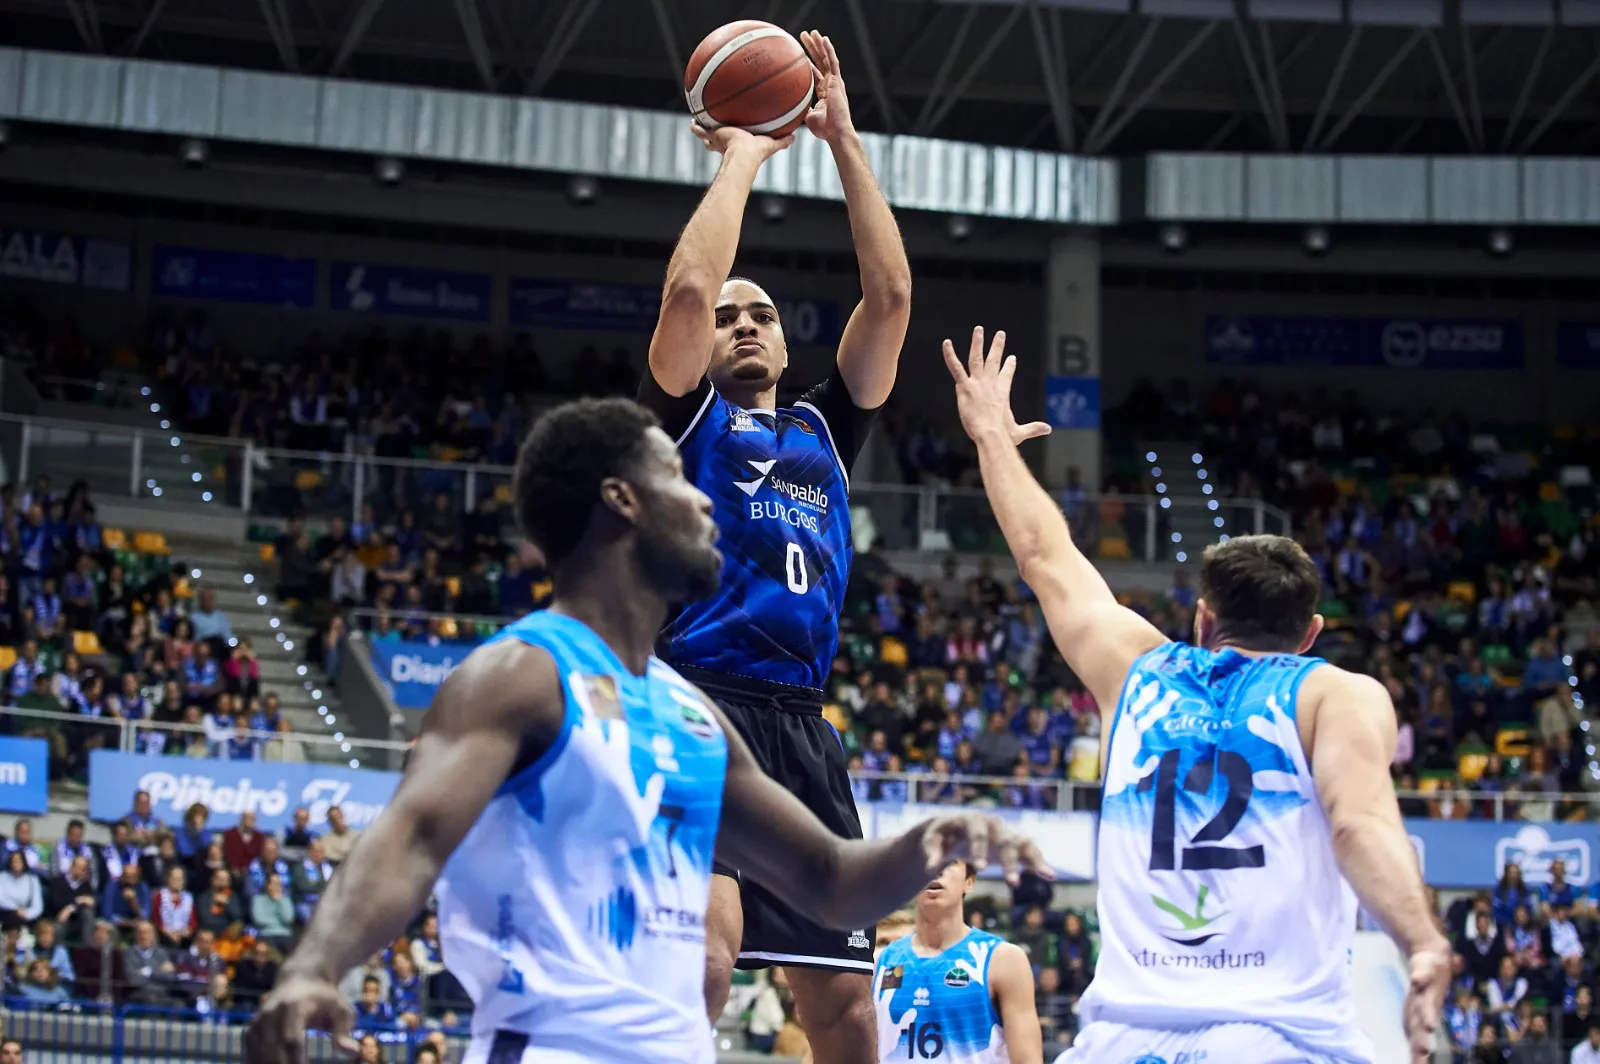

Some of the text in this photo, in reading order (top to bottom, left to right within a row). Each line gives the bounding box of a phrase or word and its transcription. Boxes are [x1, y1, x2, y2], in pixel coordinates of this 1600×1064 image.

[1058, 334, 1089, 376] B
[771, 475, 828, 508] SANpablo
[749, 501, 818, 534] BURGOS
[785, 541, 809, 595] 0
[1136, 748, 1266, 871] 12
[900, 1022, 944, 1060] 16
